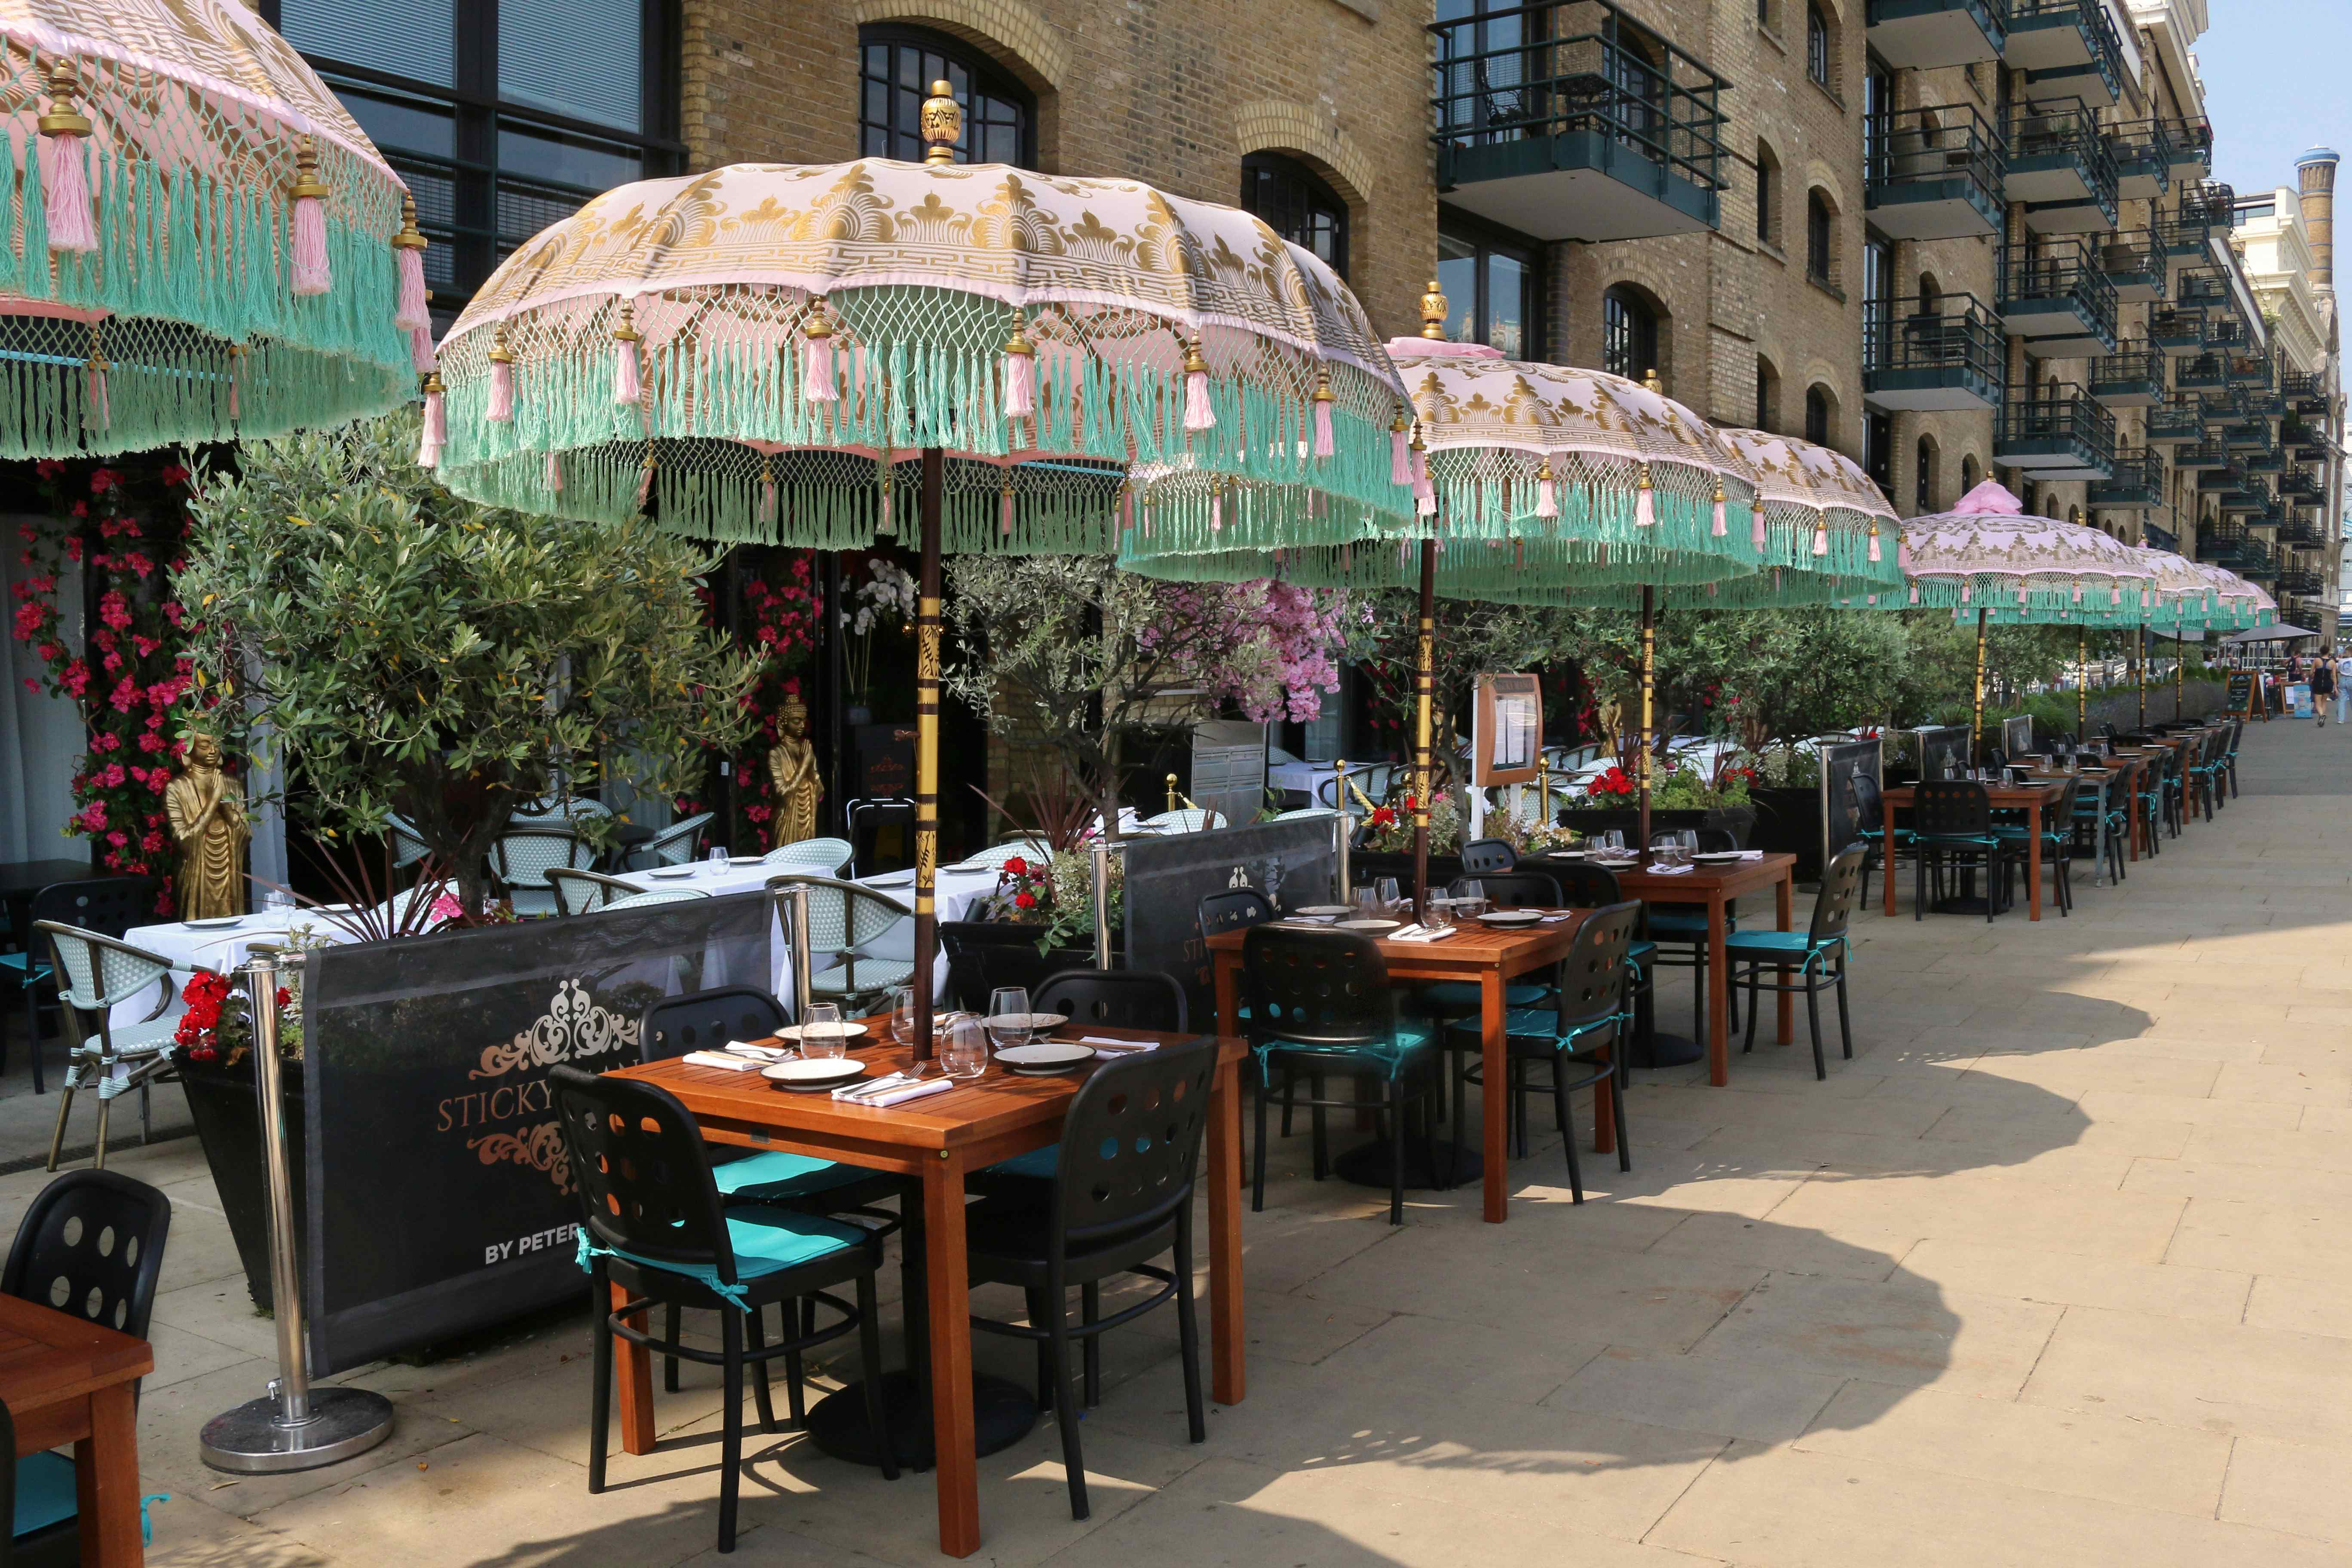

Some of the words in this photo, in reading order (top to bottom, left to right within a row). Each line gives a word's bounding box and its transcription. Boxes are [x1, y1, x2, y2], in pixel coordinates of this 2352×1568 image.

[437, 1079, 552, 1132] STICKY
[485, 1240, 513, 1265] BY
[519, 1222, 580, 1255] PETER
